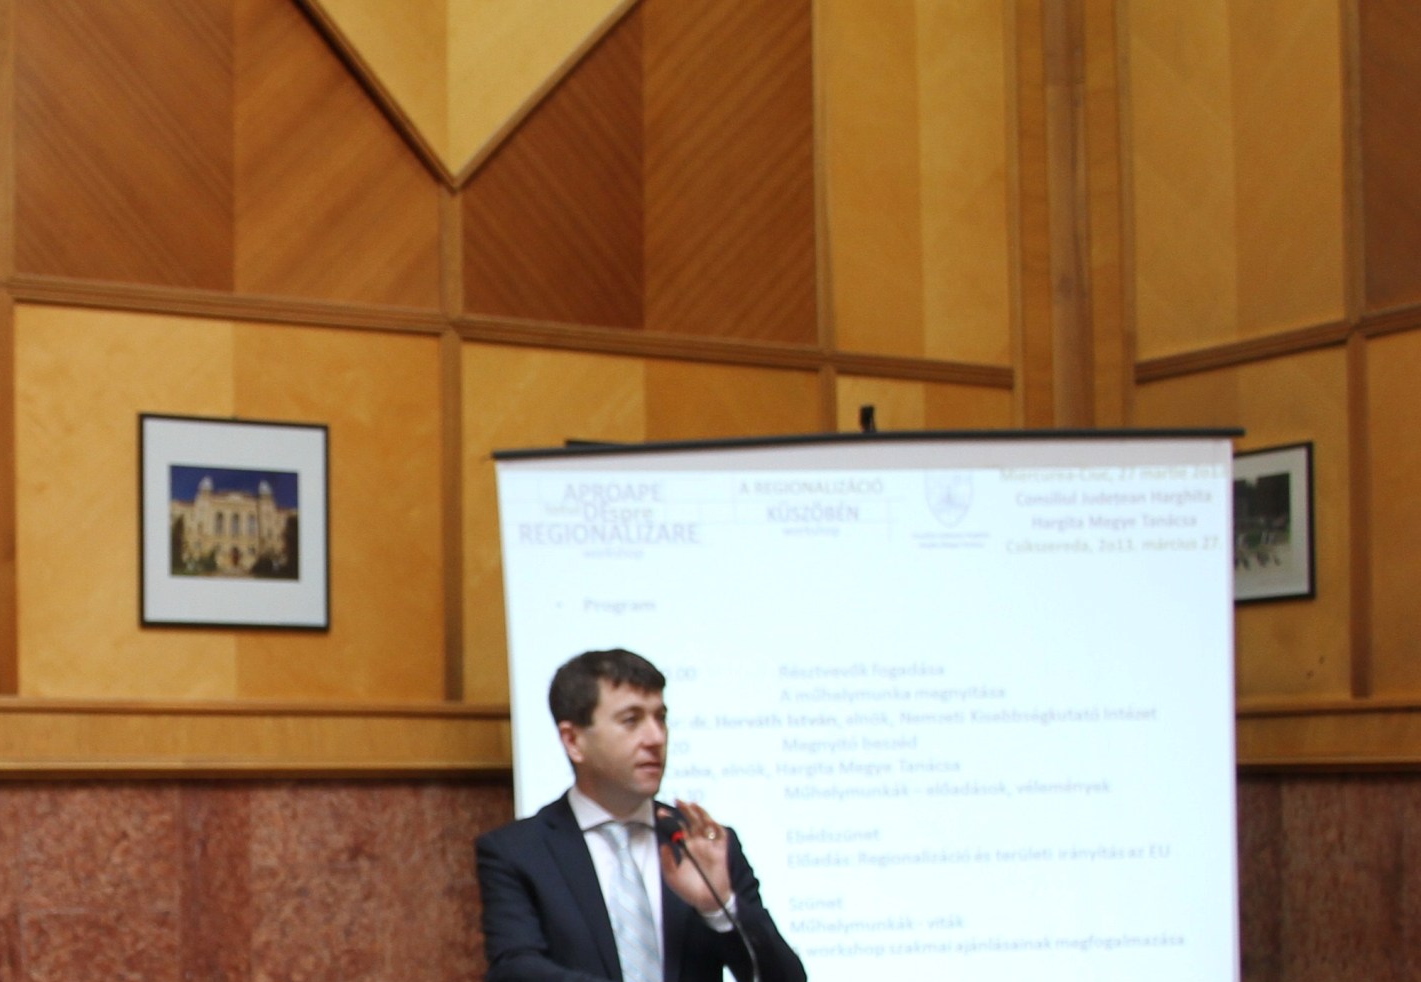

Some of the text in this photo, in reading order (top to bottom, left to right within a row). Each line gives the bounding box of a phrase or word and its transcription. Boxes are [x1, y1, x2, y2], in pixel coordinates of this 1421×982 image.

[563, 483, 662, 502] APROAPE
[740, 479, 884, 496] A REGIONALIZÁCIÓ
[1150, 487, 1213, 506] Harghita
[1032, 512, 1198, 532] Hargita Megye Tanácsa
[519, 522, 700, 545] REGIONALIZARE
[584, 598, 657, 614] Program
